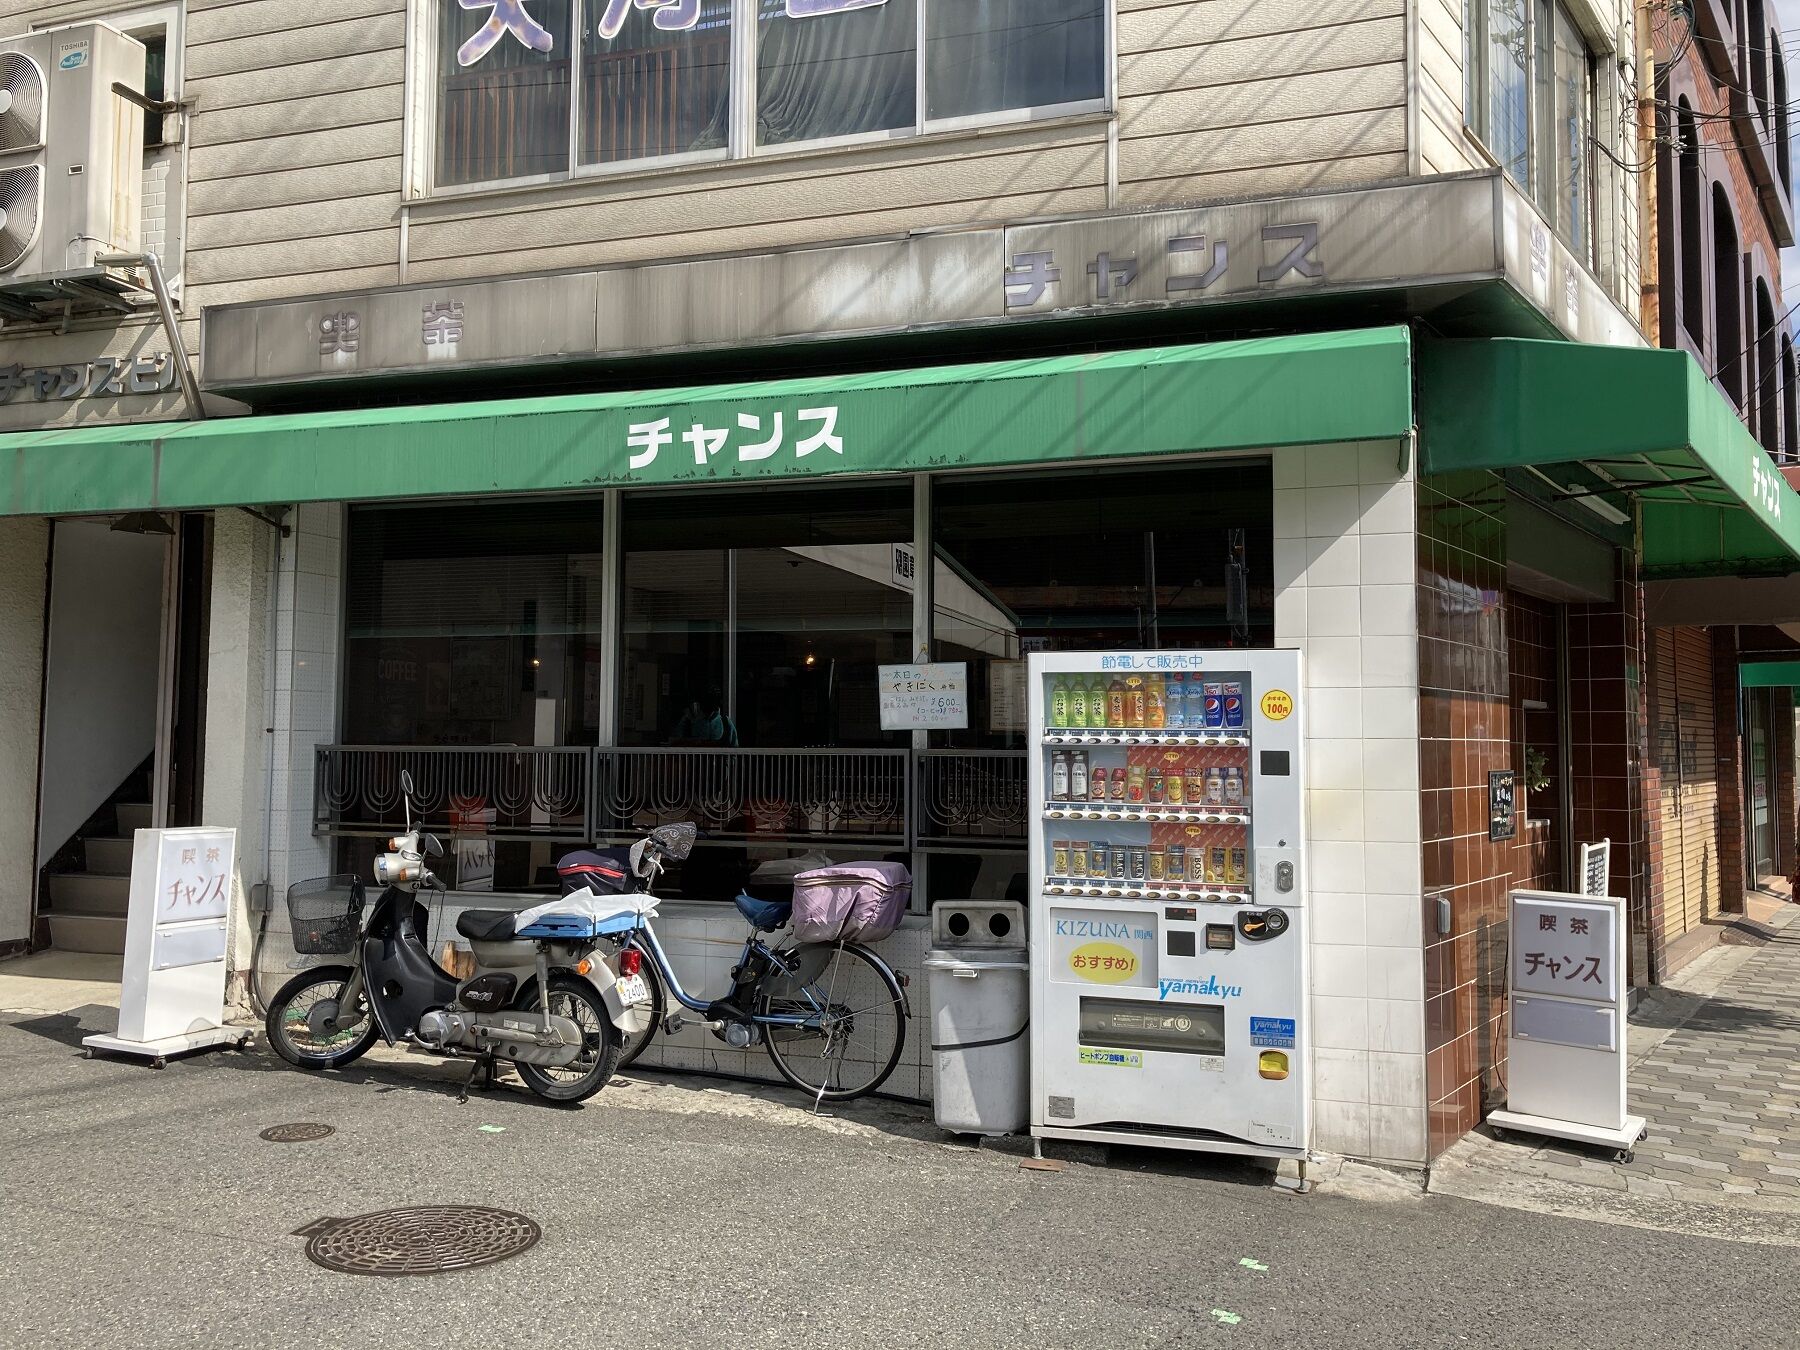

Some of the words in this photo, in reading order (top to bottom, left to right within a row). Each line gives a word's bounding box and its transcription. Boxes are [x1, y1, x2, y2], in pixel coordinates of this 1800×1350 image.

[60, 41, 88, 51] TOSHIBA
[1004, 222, 1324, 308] チャンス
[627, 406, 843, 470] チャンス
[1752, 455, 1781, 523] チャンス
[1101, 654, 1203, 669] 節電して販売中
[1267, 703, 1288, 714] 100円
[182, 847, 220, 864] 喫茶
[1116, 853, 1124, 877] BLACK
[1136, 854, 1144, 877] BLACK
[1194, 857, 1202, 880] BOSS
[167, 873, 225, 910] チャンス
[1056, 920, 1130, 938] KIZUNA
[1134, 929, 1153, 939] 関西
[1540, 914, 1588, 935] 喫茶
[1073, 954, 1134, 971] おすすめ!
[1525, 952, 1602, 984] チャンス
[1159, 975, 1242, 1000] yamakyu
[1254, 1020, 1292, 1031] yamakyu
